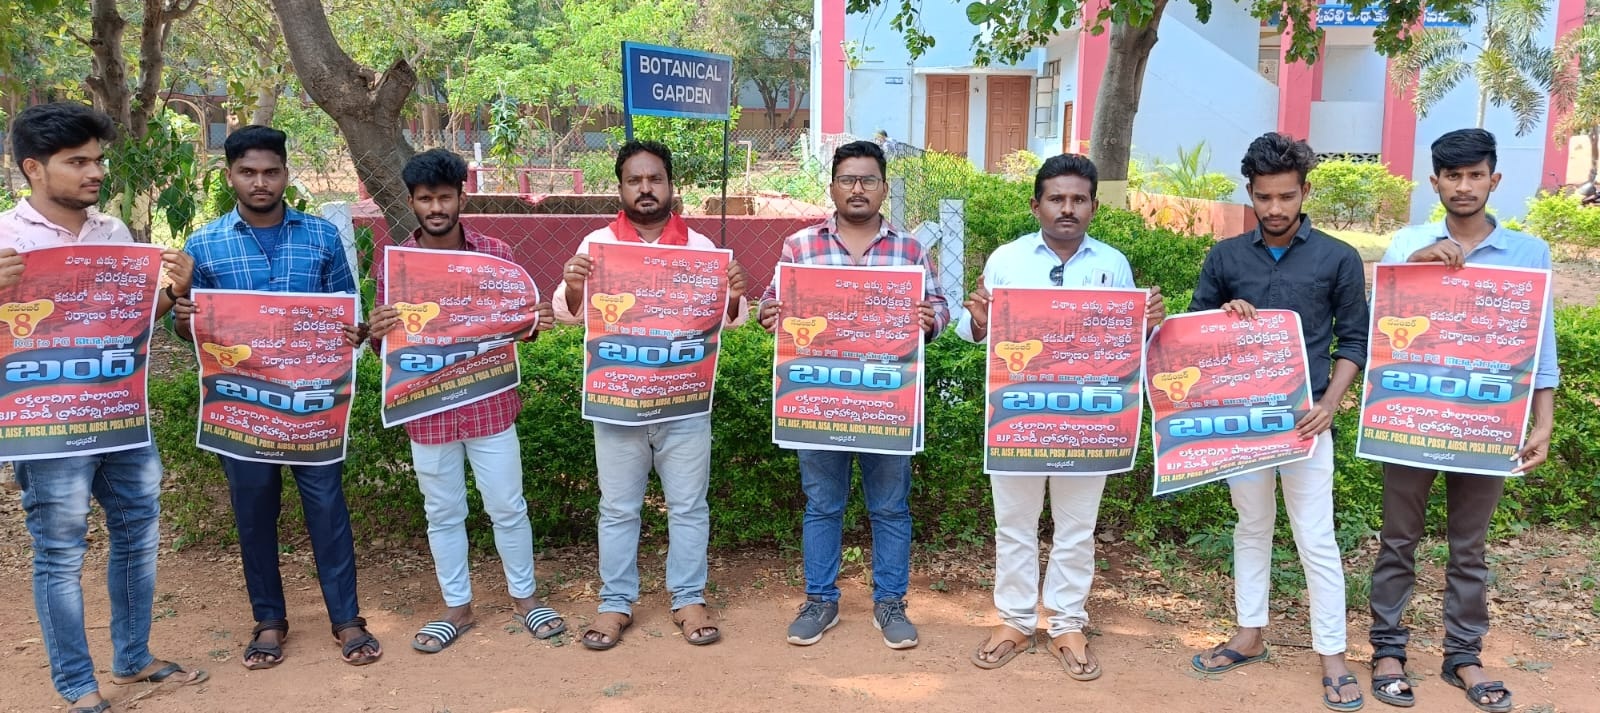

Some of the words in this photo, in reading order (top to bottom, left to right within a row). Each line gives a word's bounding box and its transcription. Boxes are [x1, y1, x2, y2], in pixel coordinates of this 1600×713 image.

[640, 55, 722, 81] BOTANICAL
[652, 83, 711, 104] GARDEN
[407, 315, 421, 332] 8
[605, 304, 617, 322] 8
[14, 314, 31, 336] 8
[37, 339, 50, 347] to
[796, 328, 809, 346] 8
[1393, 327, 1409, 349] 8
[599, 339, 704, 364] బంద్
[1010, 352, 1024, 371] 8
[6, 348, 135, 382] బంద్
[593, 381, 605, 389] BJP
[789, 364, 901, 388] బంద్
[1382, 370, 1513, 402] బంద్
[216, 379, 334, 413] బంద్
[1003, 386, 1123, 412] బంద్
[1170, 382, 1185, 400] 8
[210, 413, 224, 421] BJP
[1169, 406, 1294, 437] బంద్
[1372, 415, 1387, 424] BJP
